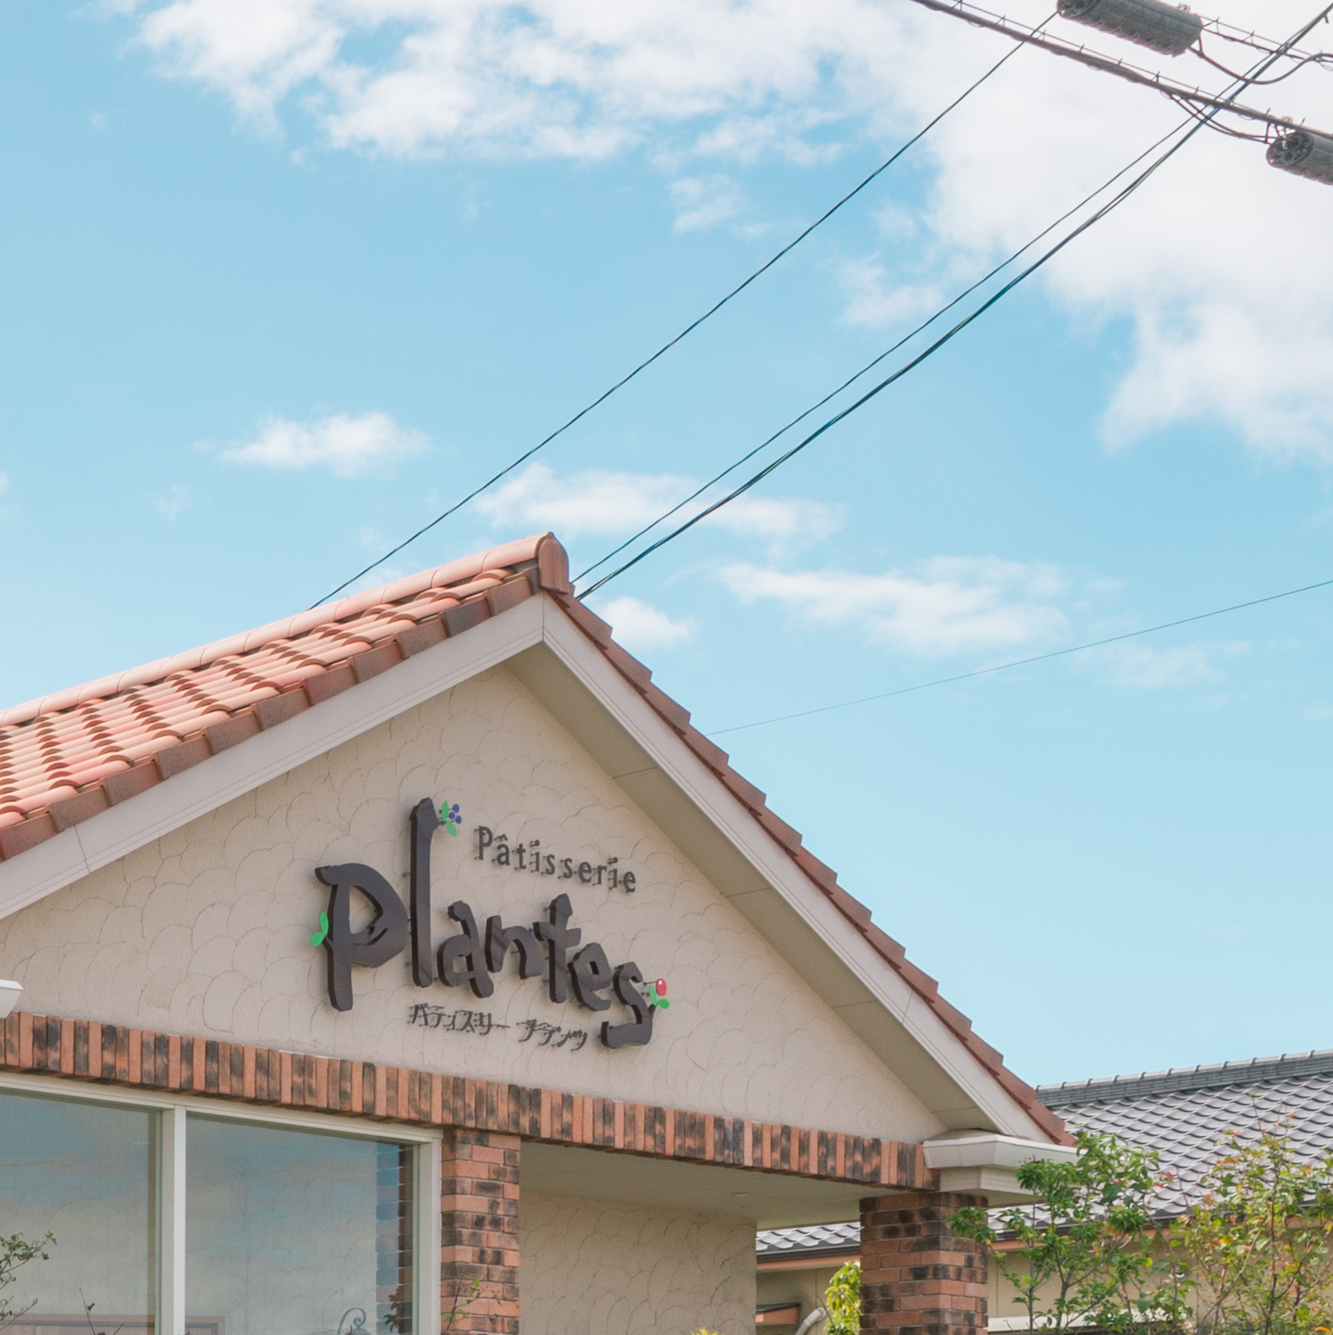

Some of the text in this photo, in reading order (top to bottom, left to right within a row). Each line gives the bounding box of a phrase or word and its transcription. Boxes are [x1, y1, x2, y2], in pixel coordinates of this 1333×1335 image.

[475, 826, 636, 893] Pâtisserie
[408, 1003, 511, 1035] パティスリー
